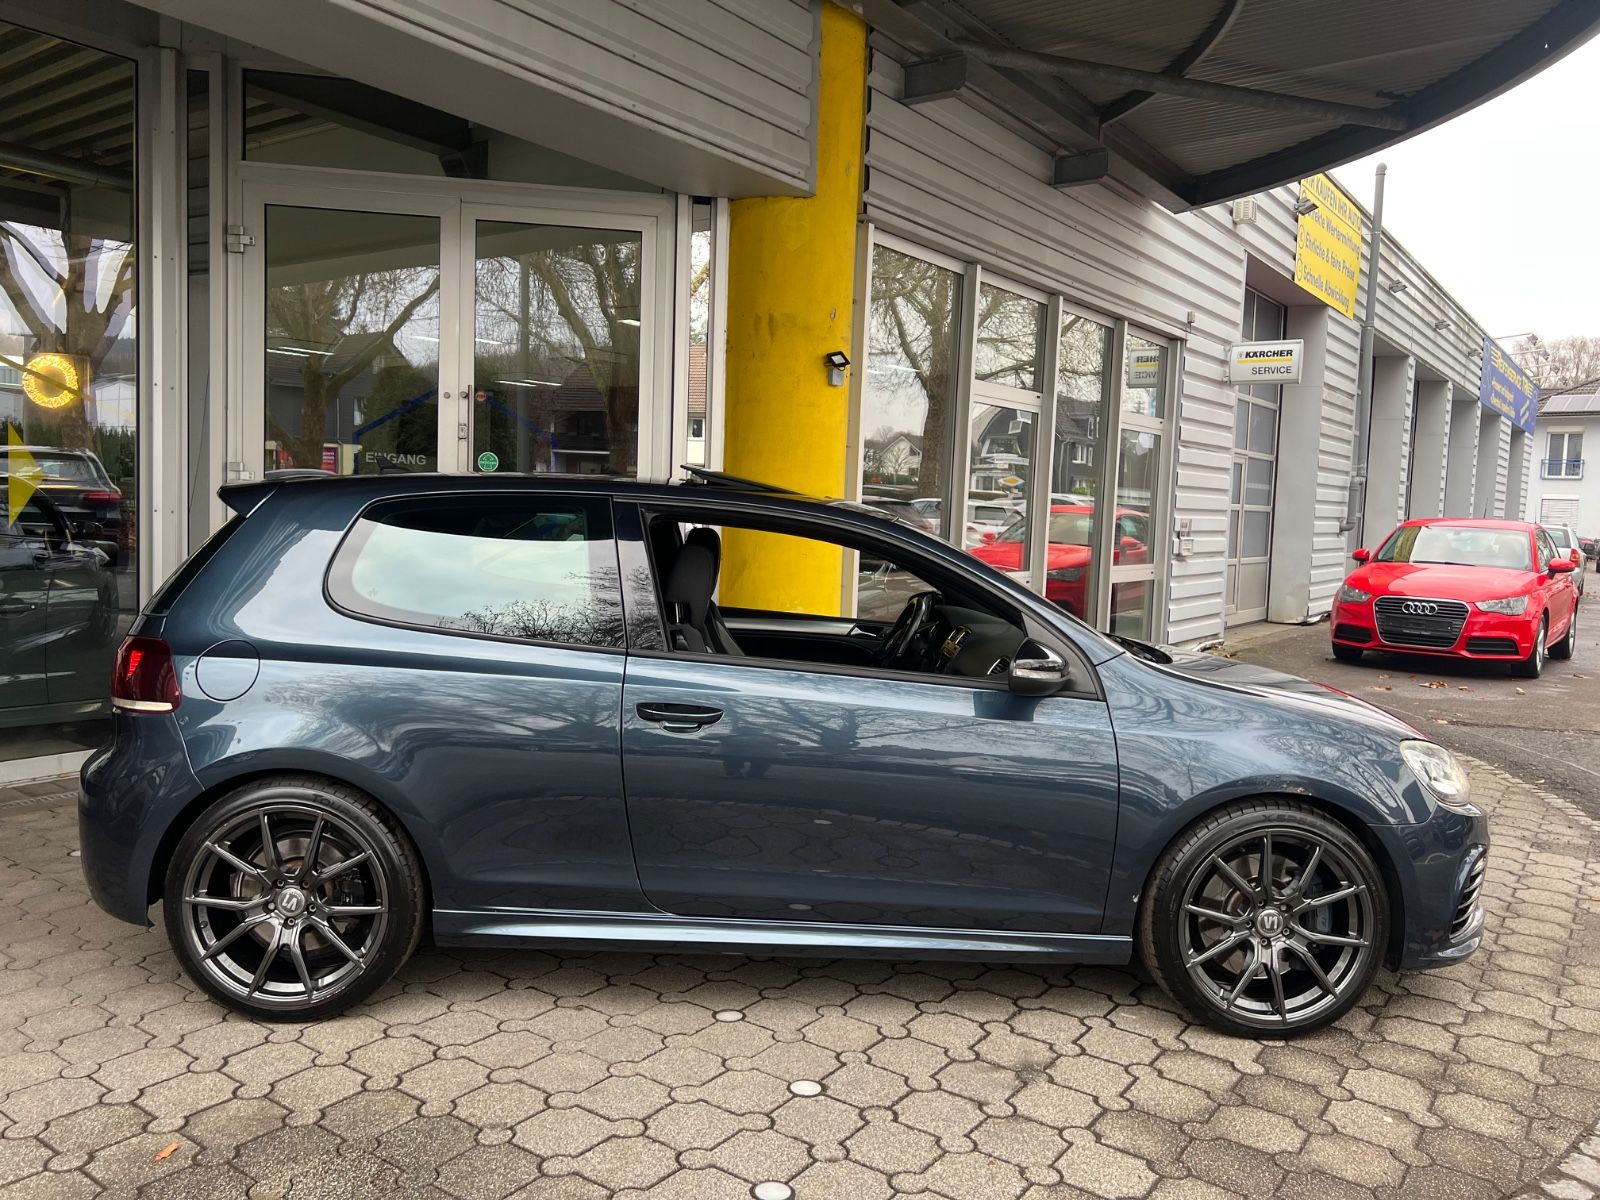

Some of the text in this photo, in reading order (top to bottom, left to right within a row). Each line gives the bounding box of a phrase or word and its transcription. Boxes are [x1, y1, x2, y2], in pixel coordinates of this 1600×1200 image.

[1316, 177, 1337, 210] KAUFEN
[1337, 198, 1348, 220] IHR
[1306, 231, 1325, 260] Ehrliche
[1331, 251, 1341, 271] faire
[1342, 259, 1355, 281] Preise
[1303, 264, 1350, 313] Schnelle Abwicklung
[1251, 366, 1292, 375] SERVICE
